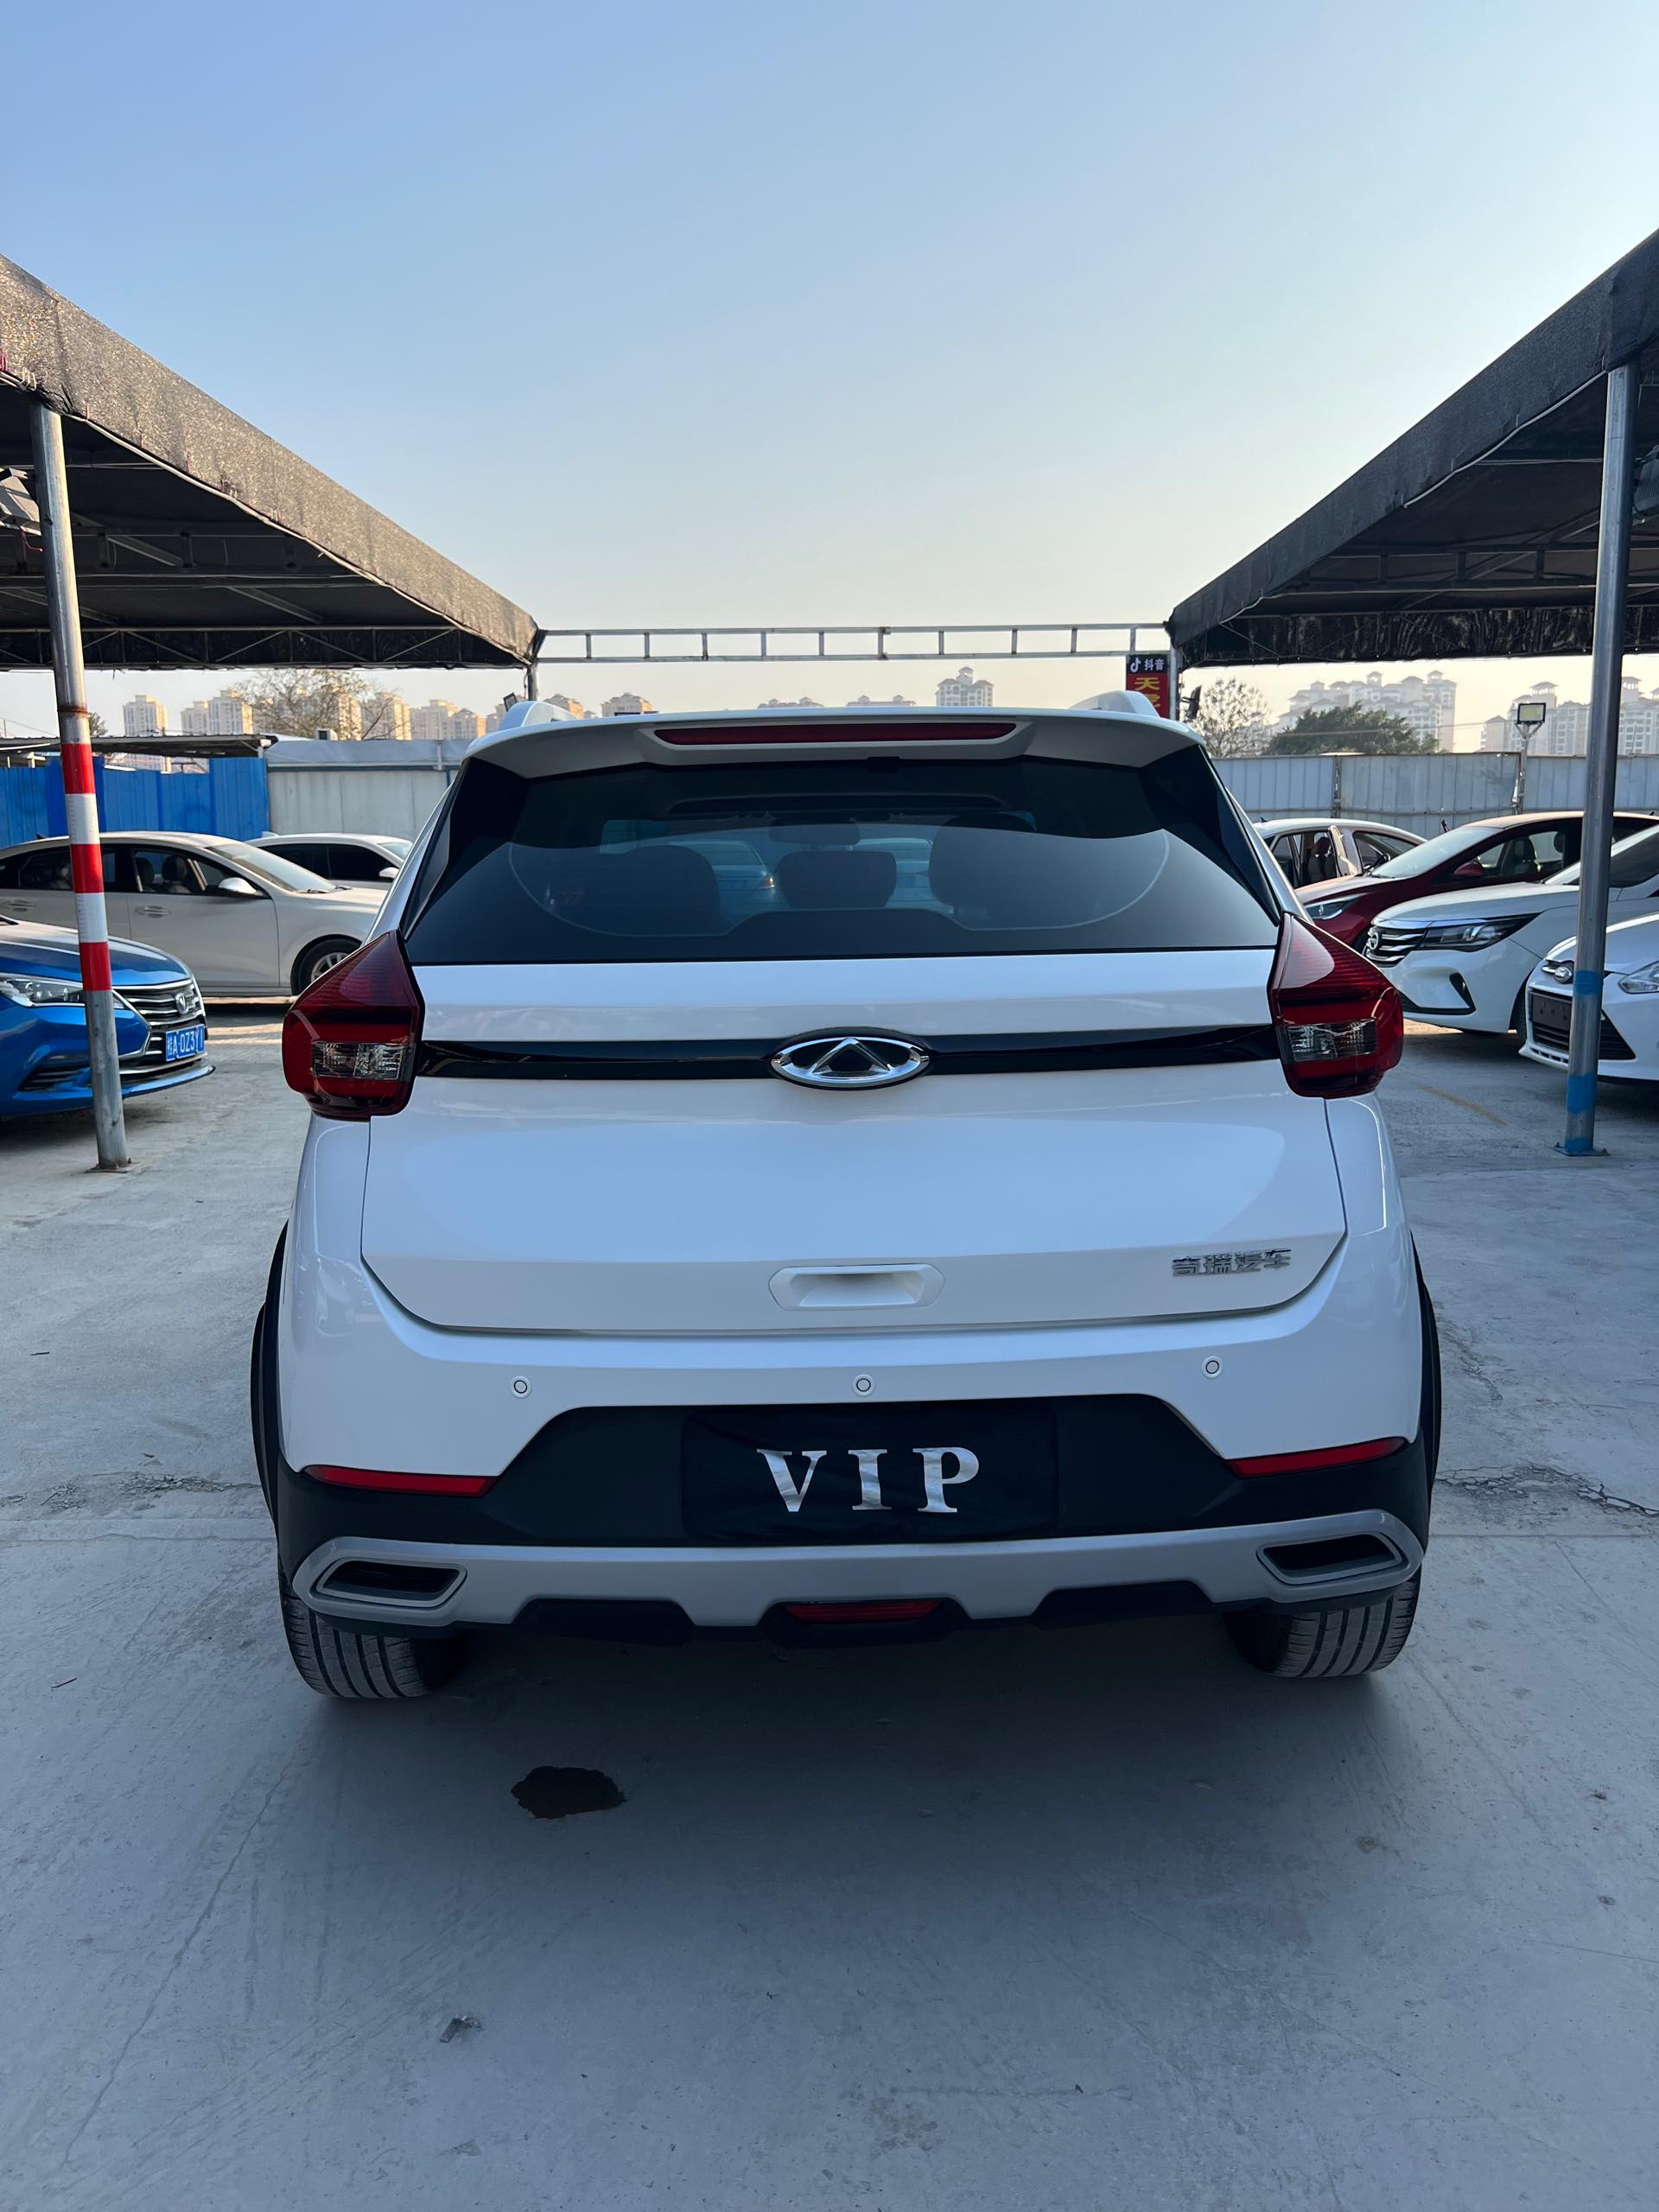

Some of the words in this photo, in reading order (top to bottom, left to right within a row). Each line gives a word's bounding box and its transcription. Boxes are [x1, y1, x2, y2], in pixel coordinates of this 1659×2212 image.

[1144, 658, 1165, 671] 抖音
[1172, 1249, 1292, 1277] 奇瑞汽车
[756, 1446, 980, 1513] VIP
